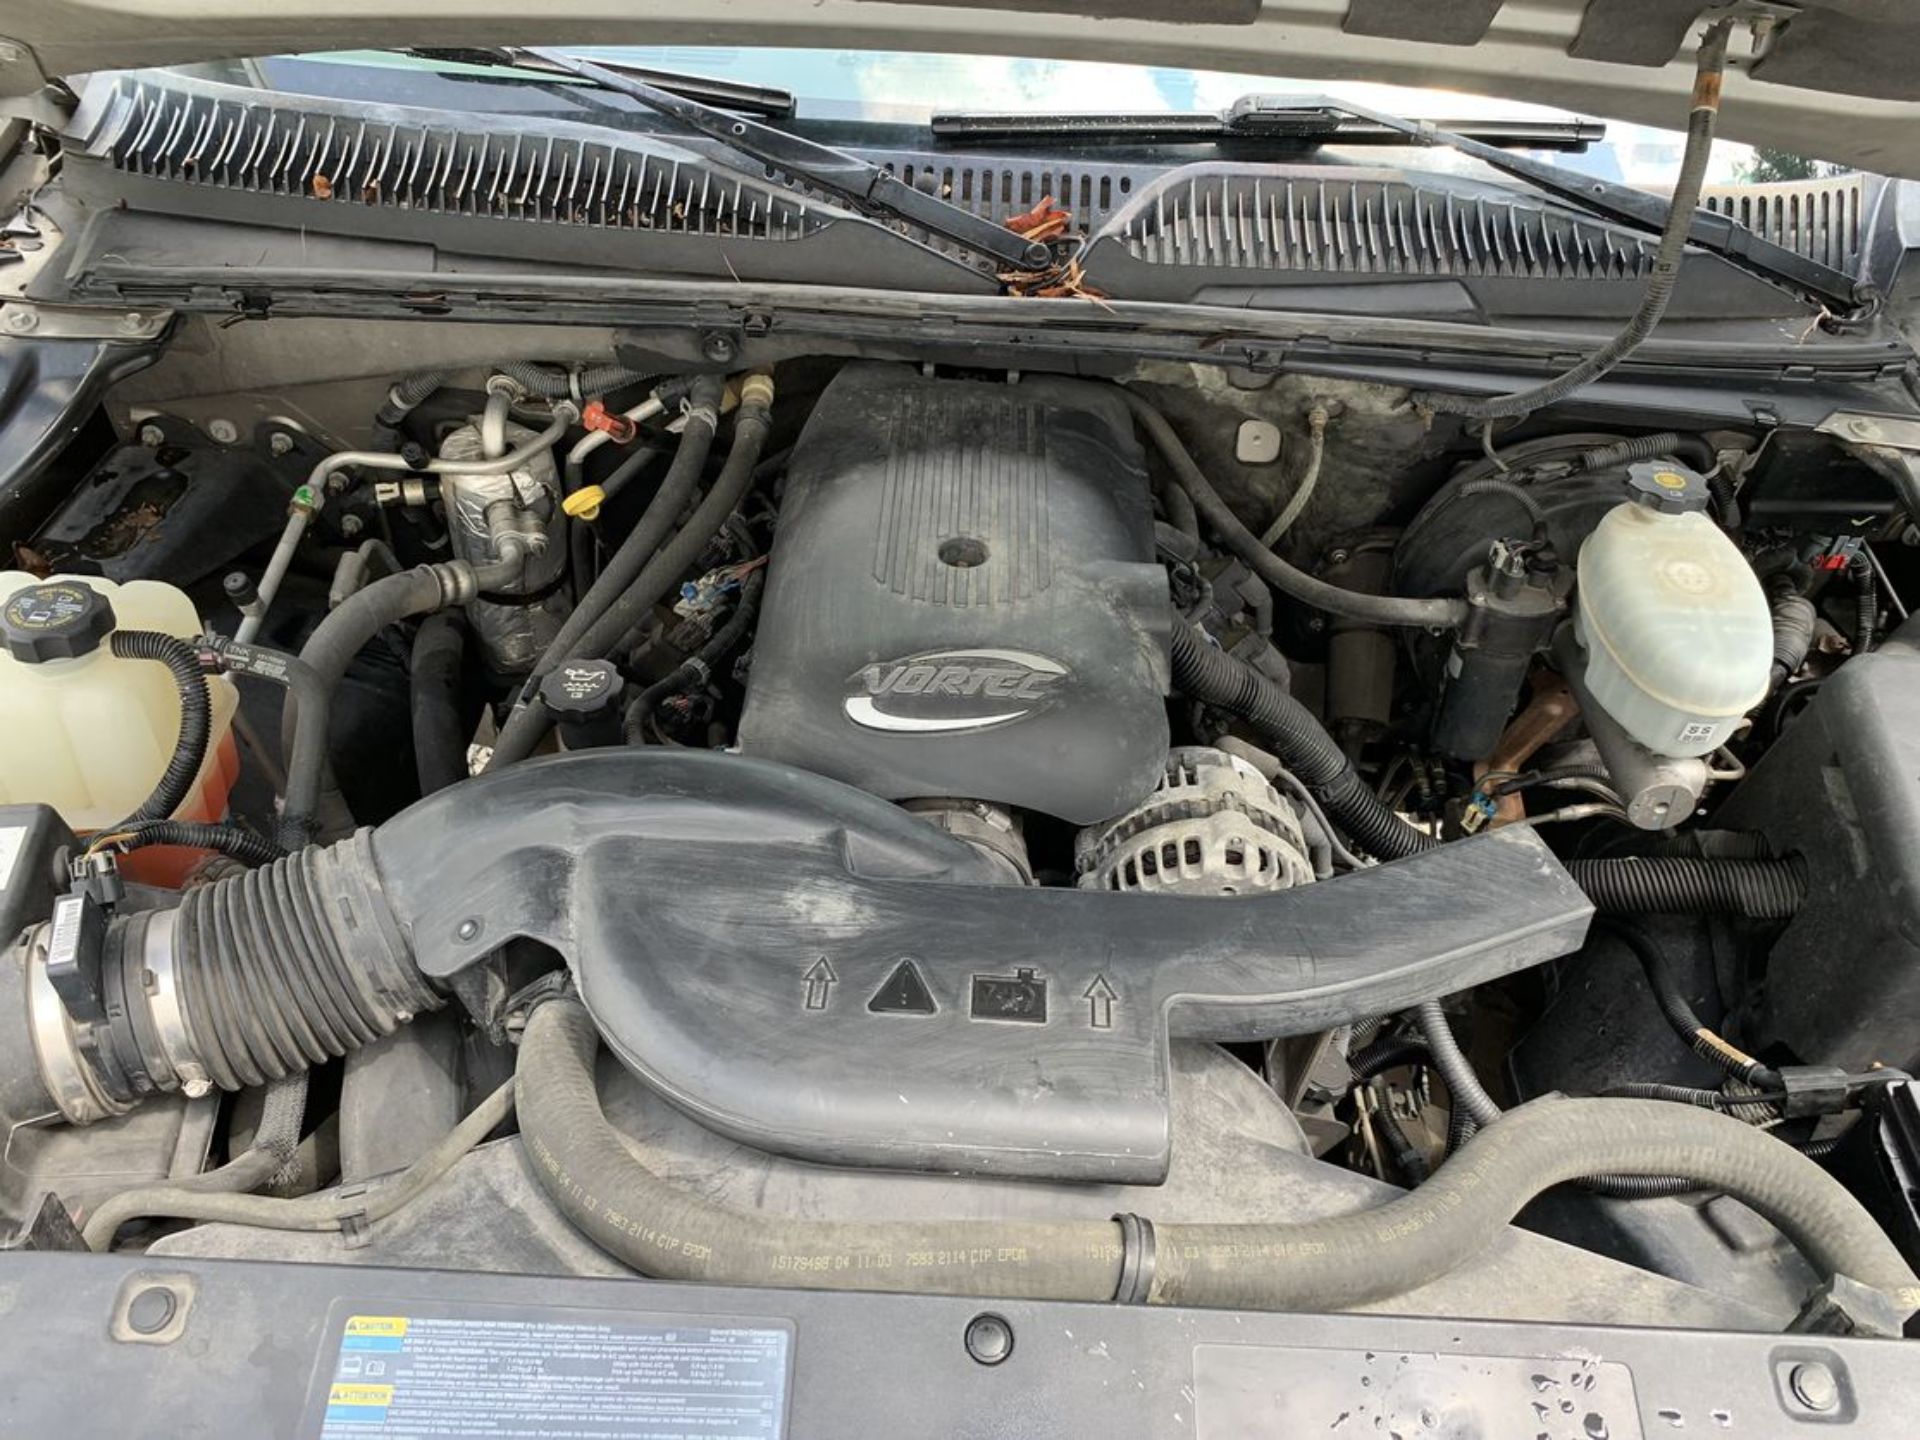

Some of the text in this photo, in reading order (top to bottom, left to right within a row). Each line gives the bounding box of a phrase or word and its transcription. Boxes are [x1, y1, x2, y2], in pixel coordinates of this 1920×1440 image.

[858, 663, 1063, 700] VORTEC
[628, 1222, 656, 1243] 2114
[970, 1248, 992, 1264] CIP
